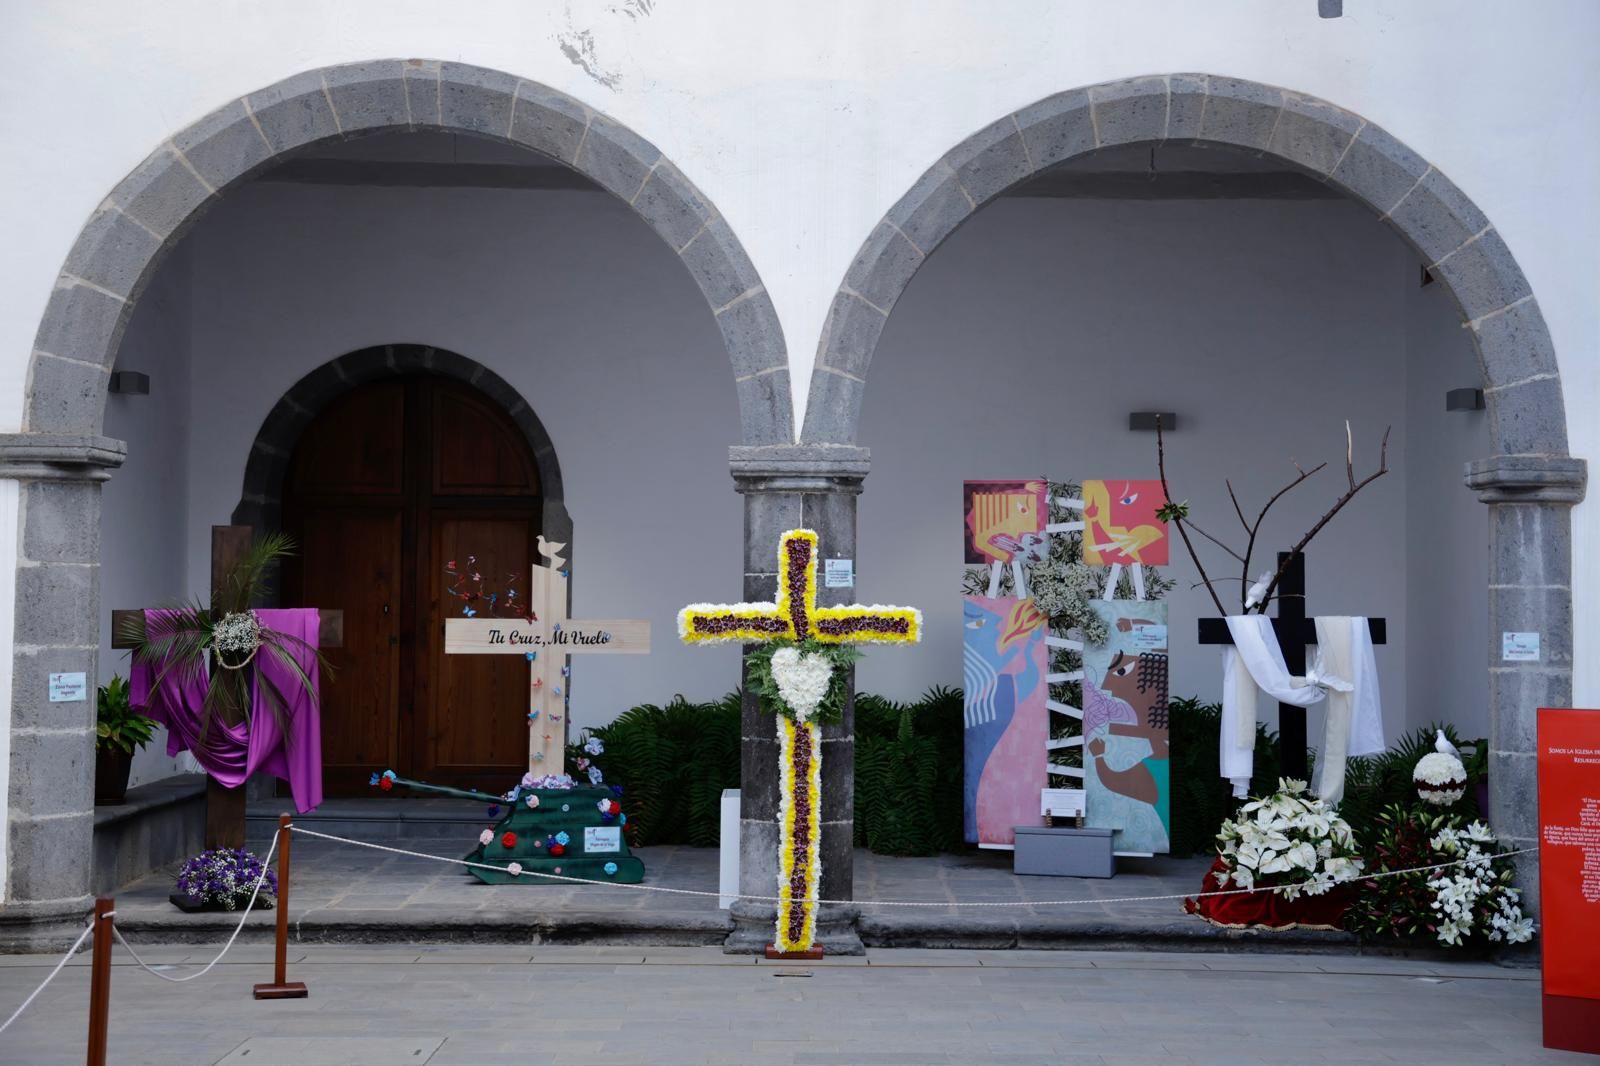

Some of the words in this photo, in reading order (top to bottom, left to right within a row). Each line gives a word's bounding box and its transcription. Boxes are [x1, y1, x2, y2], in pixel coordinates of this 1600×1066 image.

[488, 629, 505, 644] Tu
[509, 629, 546, 647] Cruz,
[547, 630, 569, 645] Mi
[570, 630, 609, 645] Vuelo
